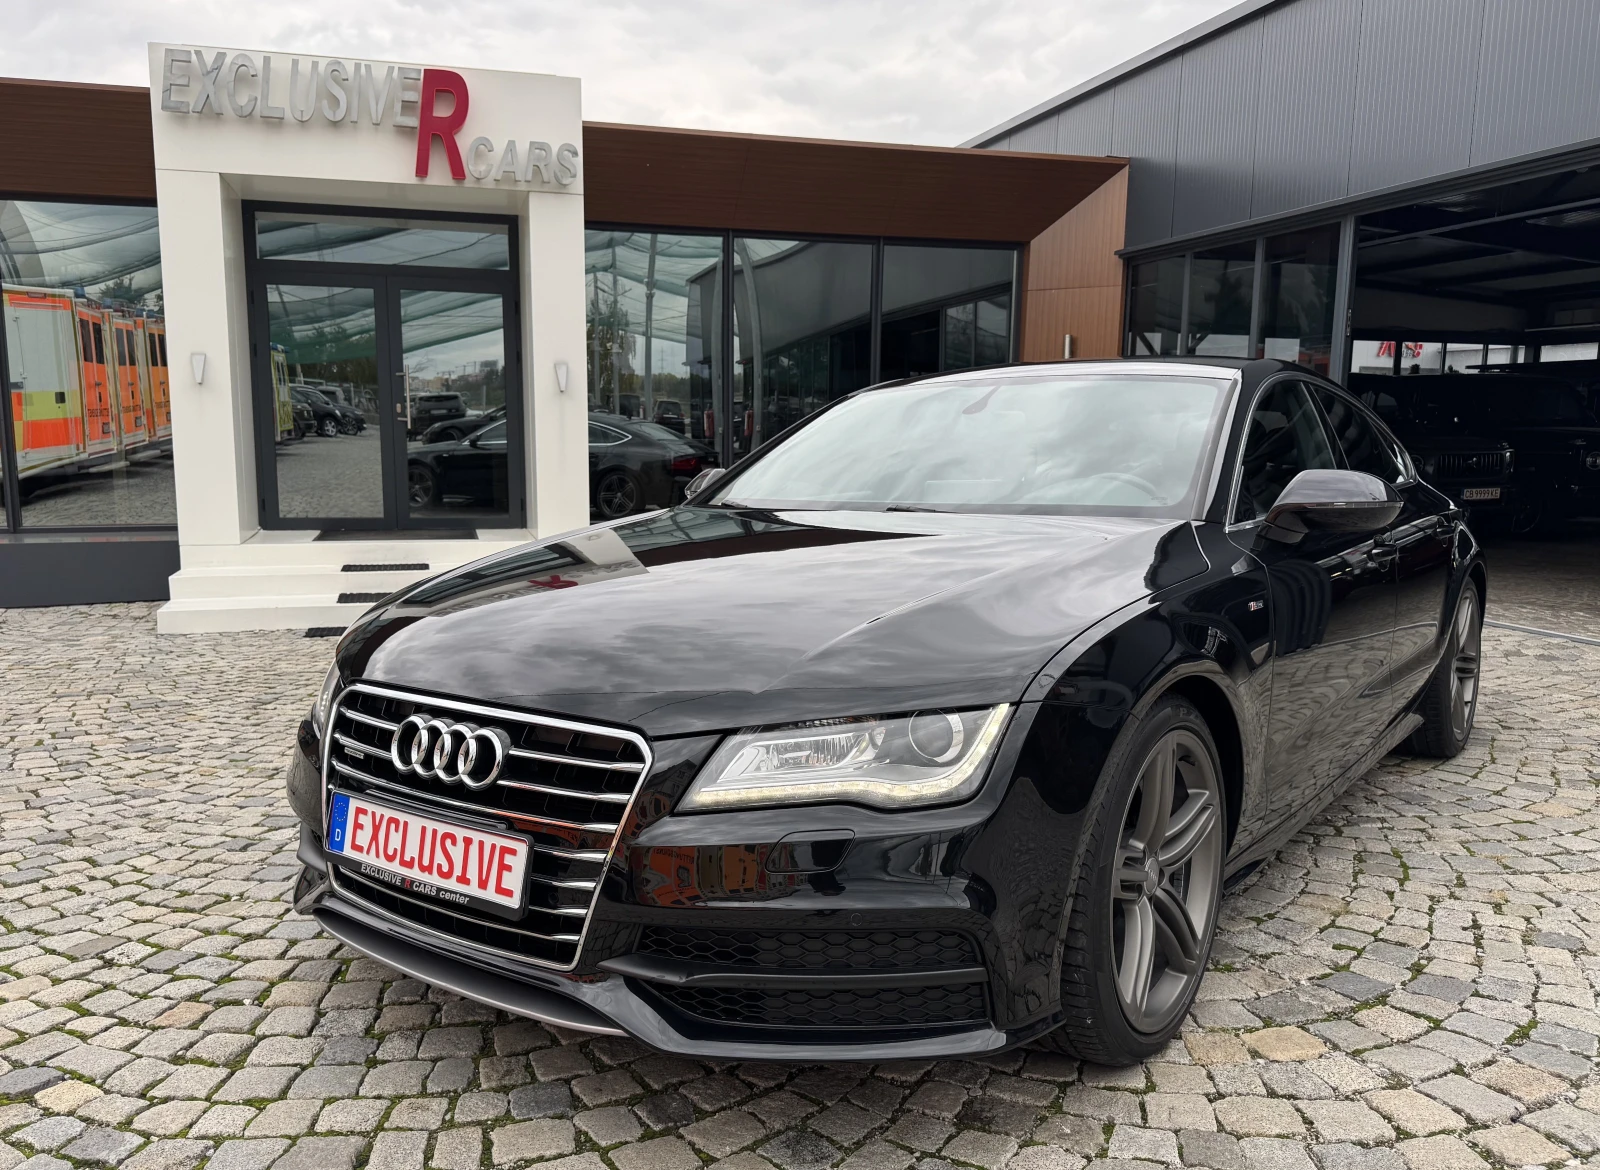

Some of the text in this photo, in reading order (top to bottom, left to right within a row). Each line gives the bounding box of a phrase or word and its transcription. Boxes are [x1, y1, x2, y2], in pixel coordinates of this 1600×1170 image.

[161, 48, 579, 186] EXCLUSIVE R CARS
[1474, 489, 1490, 498] 9999
[334, 828, 342, 842] D
[350, 806, 518, 898] EXCLUSIVE
[361, 863, 470, 905] EXCLUSIVE R CARS center
